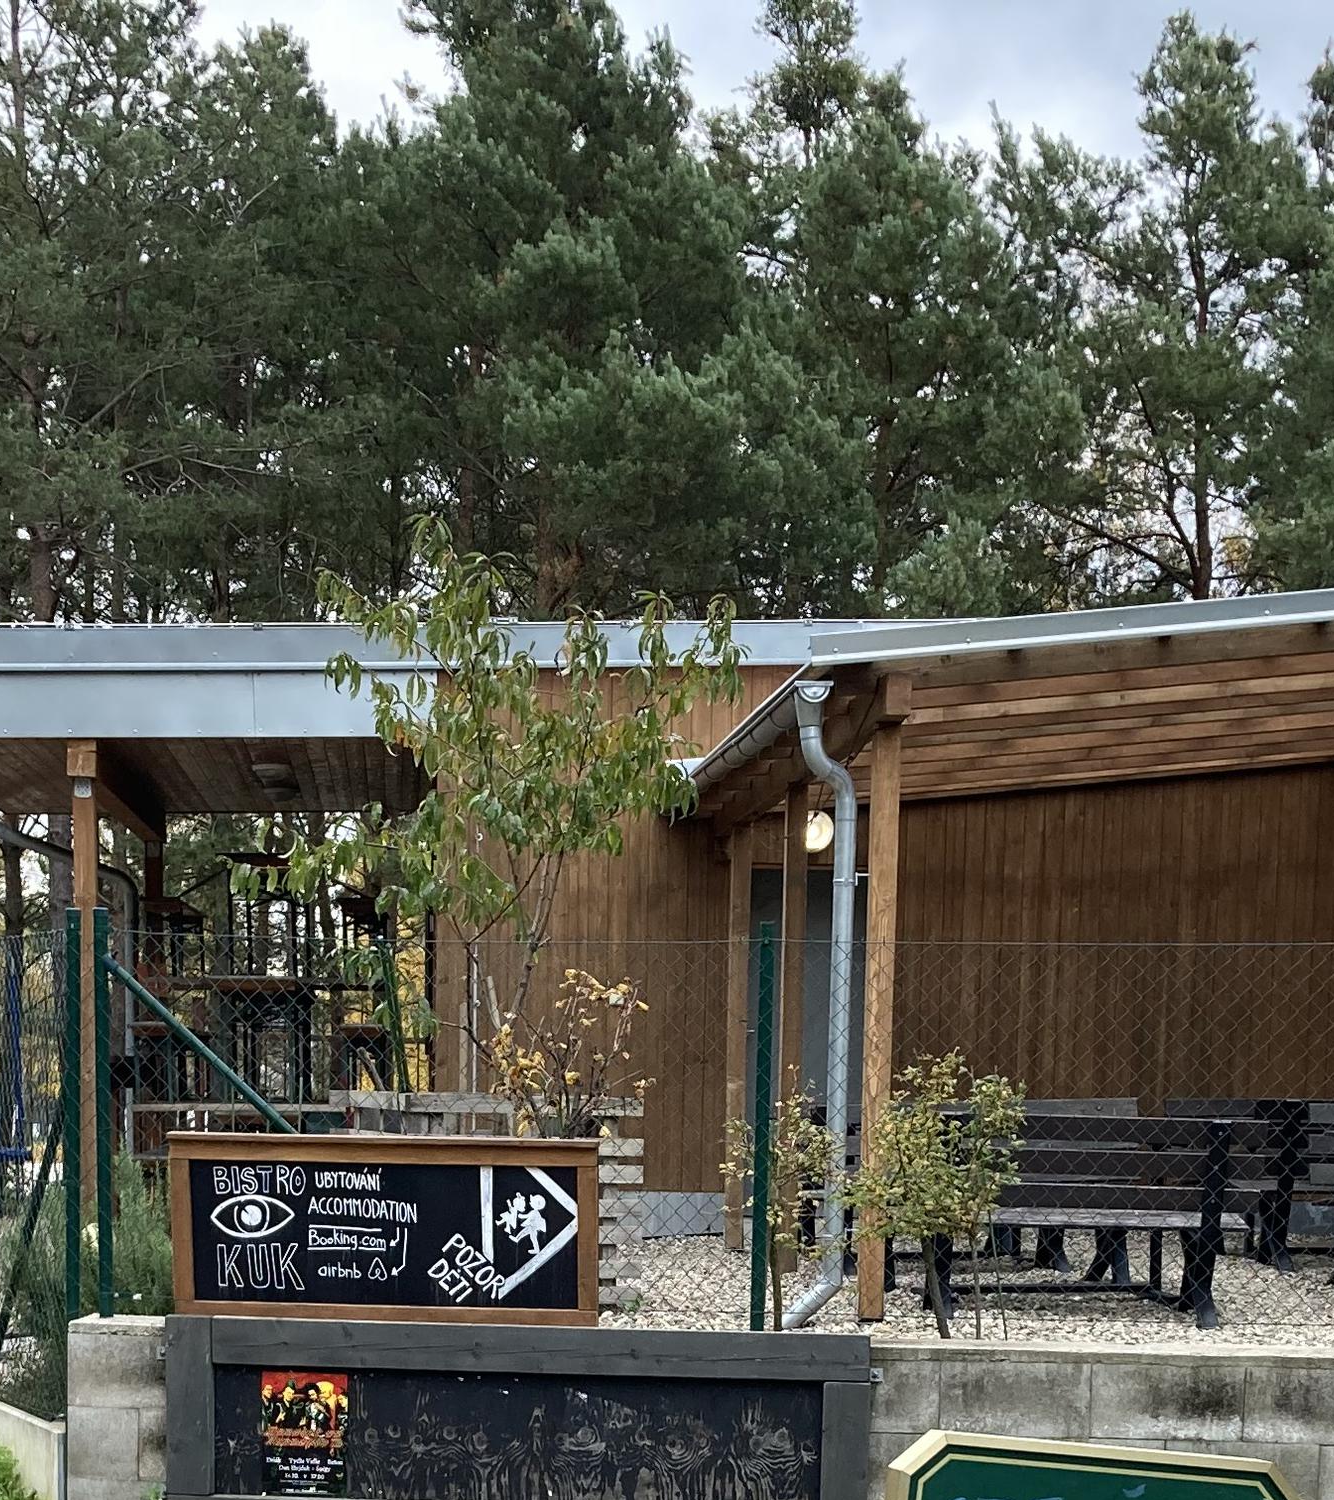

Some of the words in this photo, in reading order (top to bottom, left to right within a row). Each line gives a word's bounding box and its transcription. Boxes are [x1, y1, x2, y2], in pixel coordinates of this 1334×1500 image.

[213, 1165, 306, 1196] BISTRO
[314, 1167, 382, 1191] UBYTOVÁNÍ
[307, 1196, 417, 1224] ACCOMMODATION
[308, 1228, 386, 1250] Booking.com
[217, 1242, 305, 1290] KUK
[317, 1261, 362, 1279] airbnb
[441, 1232, 505, 1299] POZOR
